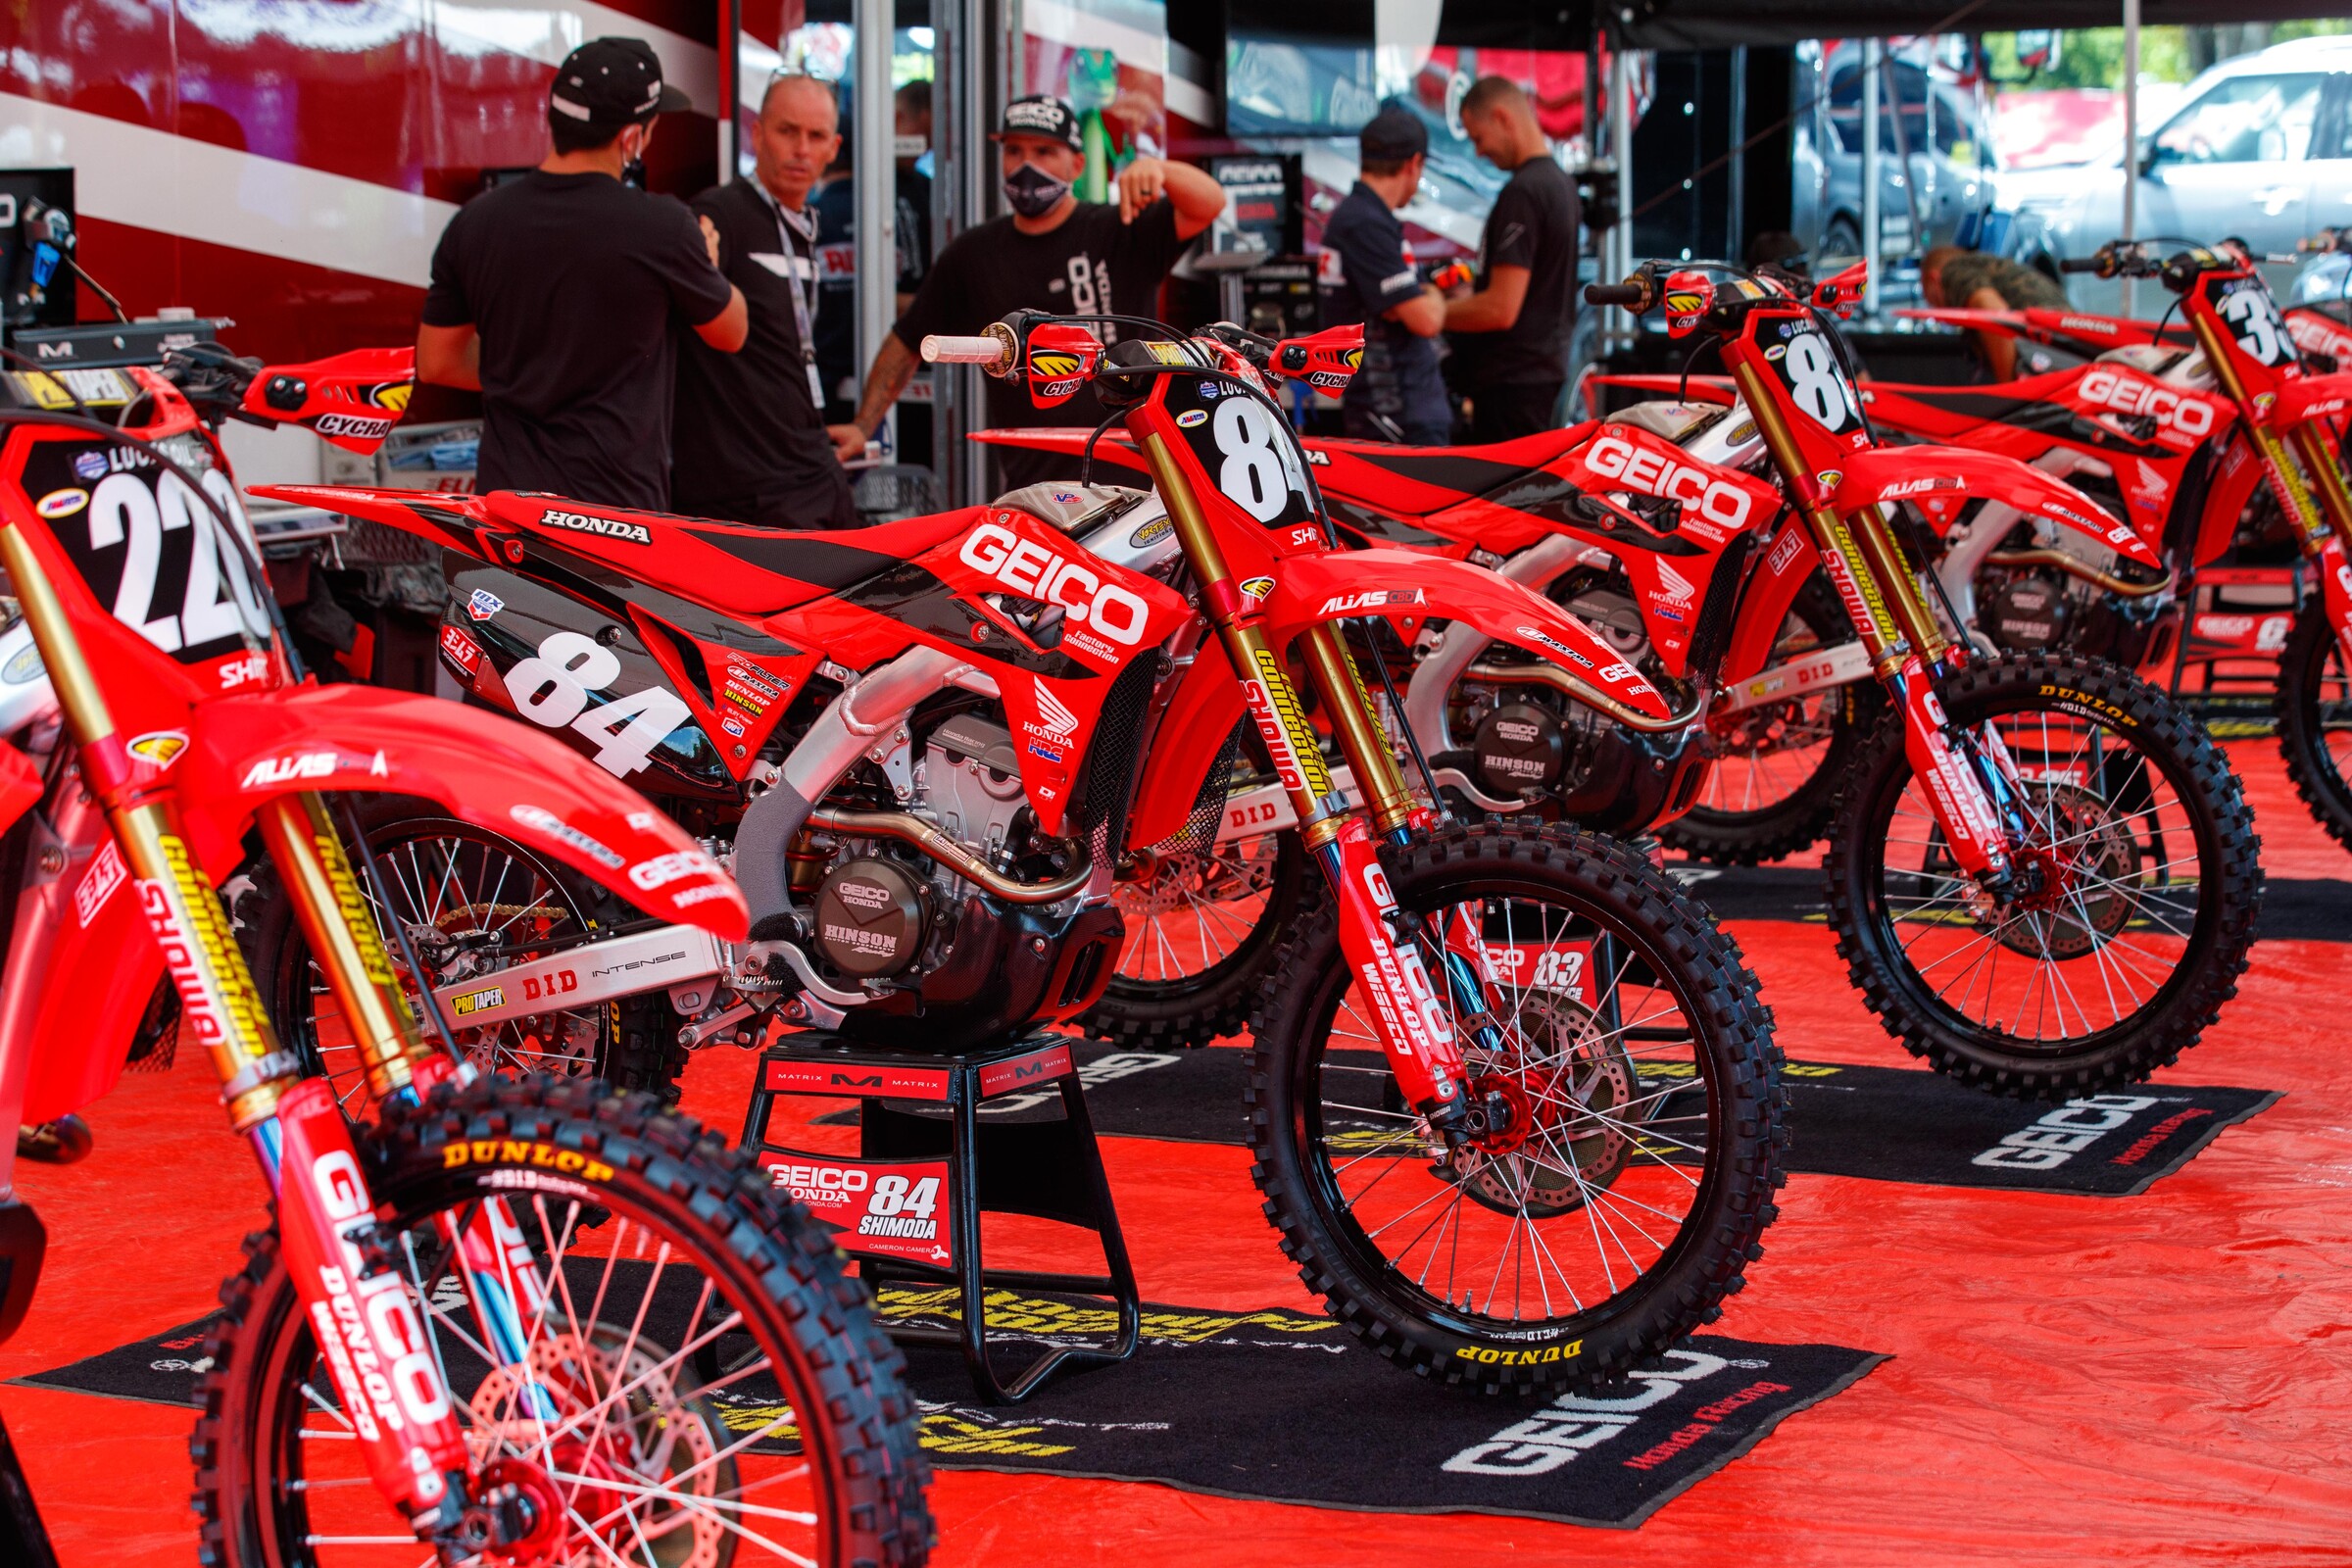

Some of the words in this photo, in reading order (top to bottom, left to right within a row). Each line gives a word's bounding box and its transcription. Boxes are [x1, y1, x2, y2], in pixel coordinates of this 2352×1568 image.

[1005, 102, 1065, 124] GEICO
[1786, 332, 1859, 432] 8
[2078, 371, 2214, 435] GEICO
[1585, 437, 1752, 529] GEICO
[1879, 478, 1934, 499] ALIAS
[541, 511, 651, 543] HONDA
[1138, 514, 1172, 540] VORTEX
[959, 523, 1150, 646] GEICO
[1821, 549, 1876, 635] SHOWA
[1318, 591, 1388, 614] ALIAS
[1388, 591, 1415, 604] CBD
[1648, 590, 1693, 611] HONDA
[1075, 630, 1115, 654] Factory
[727, 652, 791, 690] PROFILTER
[504, 631, 691, 778] 84
[724, 689, 762, 715] HINSON
[725, 679, 771, 707] DUNLOP
[2038, 685, 2138, 727] DUNLOP
[723, 720, 743, 737] 100%
[943, 728, 964, 741] Honda
[963, 735, 986, 749] Racing
[1023, 721, 1075, 749] HONDA
[1239, 679, 1303, 791] SHOWA
[1496, 721, 1539, 736] GEICO
[1500, 732, 1534, 742] HONDA
[1028, 737, 1063, 763] HRC
[1485, 756, 1545, 772] HINSON
[1923, 691, 1999, 829] GICO
[241, 753, 338, 789] ALIAS
[1933, 749, 1983, 833] DUNLOP
[839, 882, 890, 902] GEICO
[843, 895, 884, 909] HONDA
[824, 924, 897, 949] HINSON
[133, 878, 227, 1046] SHOWA
[592, 951, 687, 978] INTENSE
[1363, 861, 1453, 1046] GICO
[1535, 951, 1584, 986] 83
[522, 969, 578, 1001] D.I.D
[1369, 937, 1430, 1048] DUNLOP
[454, 988, 505, 1015] PROTAPER
[777, 1073, 823, 1082] MATRIX
[892, 1079, 939, 1089] MATRIX
[986, 1072, 1011, 1084] MATRIX
[1045, 1057, 1067, 1068] MATRIX
[1429, 1104, 1451, 1121] SHOWA
[1971, 1095, 2159, 1170] GEICO
[442, 1141, 614, 1182] DUNLOP
[767, 1163, 868, 1192] GEICO
[867, 1175, 941, 1219] 84
[858, 1214, 938, 1240] SHIMODA
[869, 1243, 905, 1251] CAMERON
[314, 1150, 449, 1425] GICO
[318, 1264, 404, 1432] DUNLOP
[1456, 1339, 1584, 1365] DUNLOP
